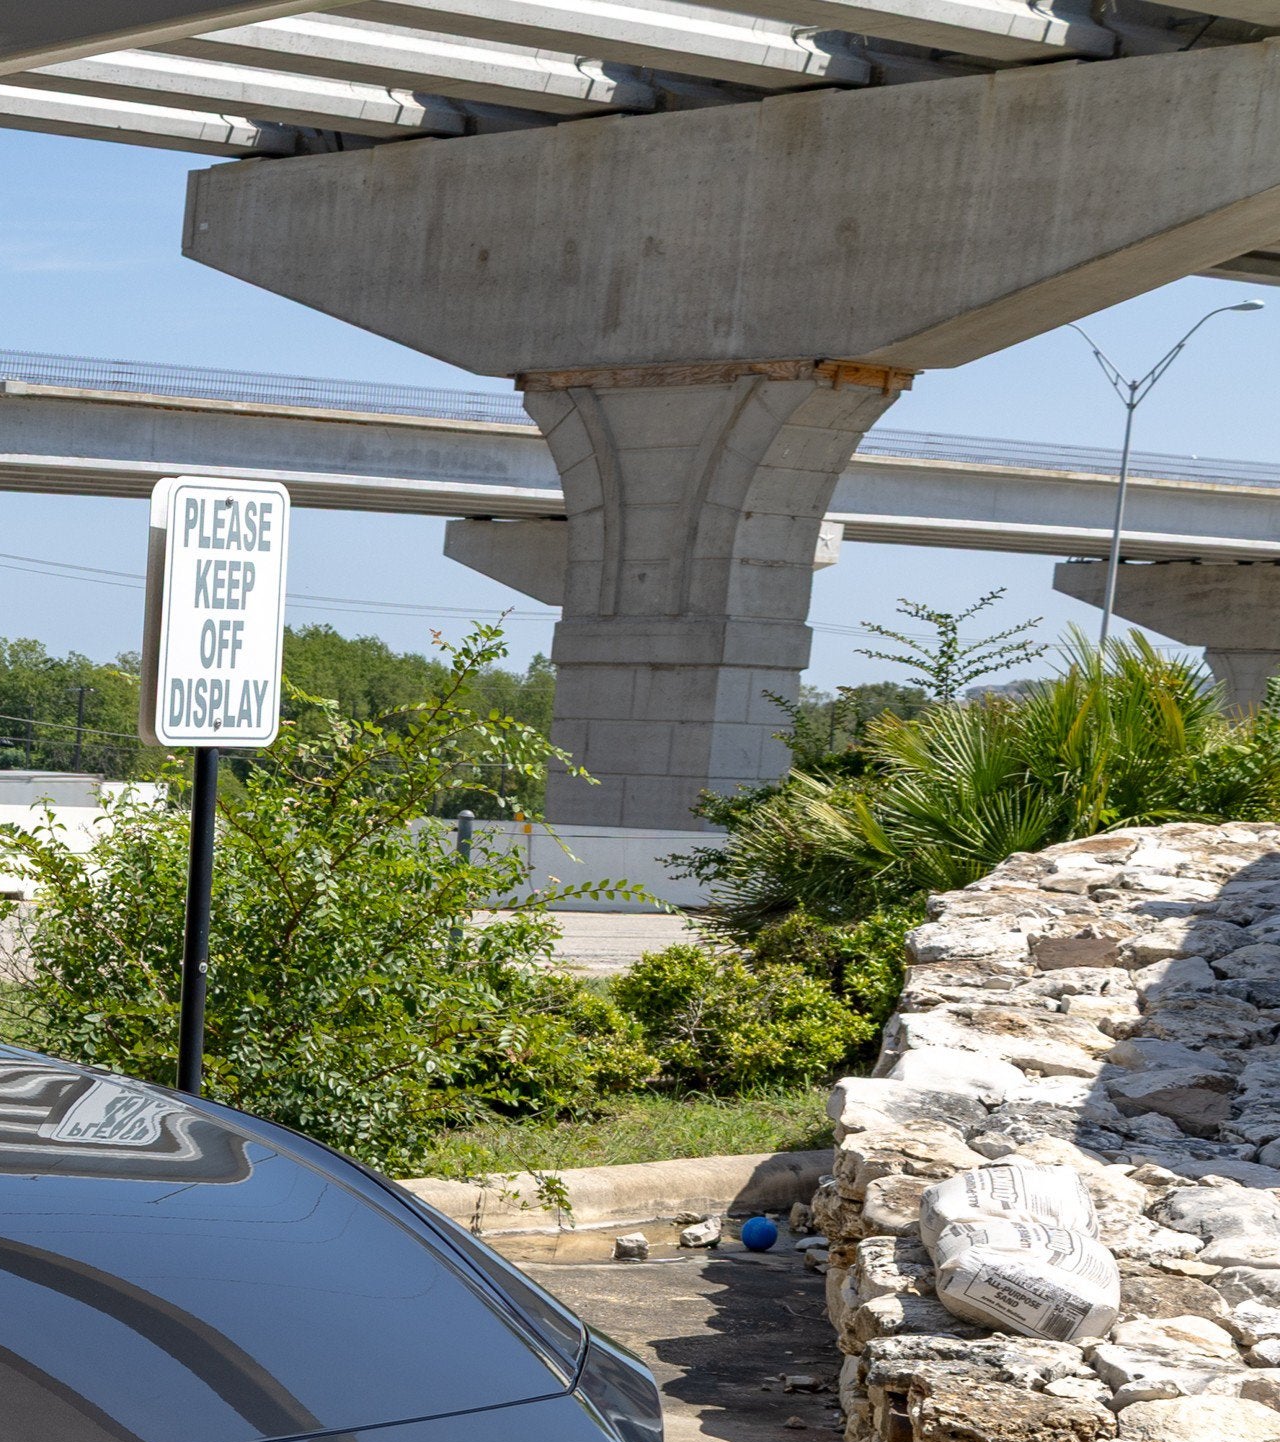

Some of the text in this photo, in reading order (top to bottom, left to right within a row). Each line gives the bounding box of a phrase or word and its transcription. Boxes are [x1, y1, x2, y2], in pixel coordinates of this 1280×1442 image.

[184, 497, 272, 552] PLEASE
[194, 559, 255, 610] KEEP
[200, 618, 244, 669] OFF
[169, 678, 268, 728] DISPLAY
[984, 1277, 1042, 1310] ALL-PURPOSE
[994, 1291, 1019, 1308] SAND
